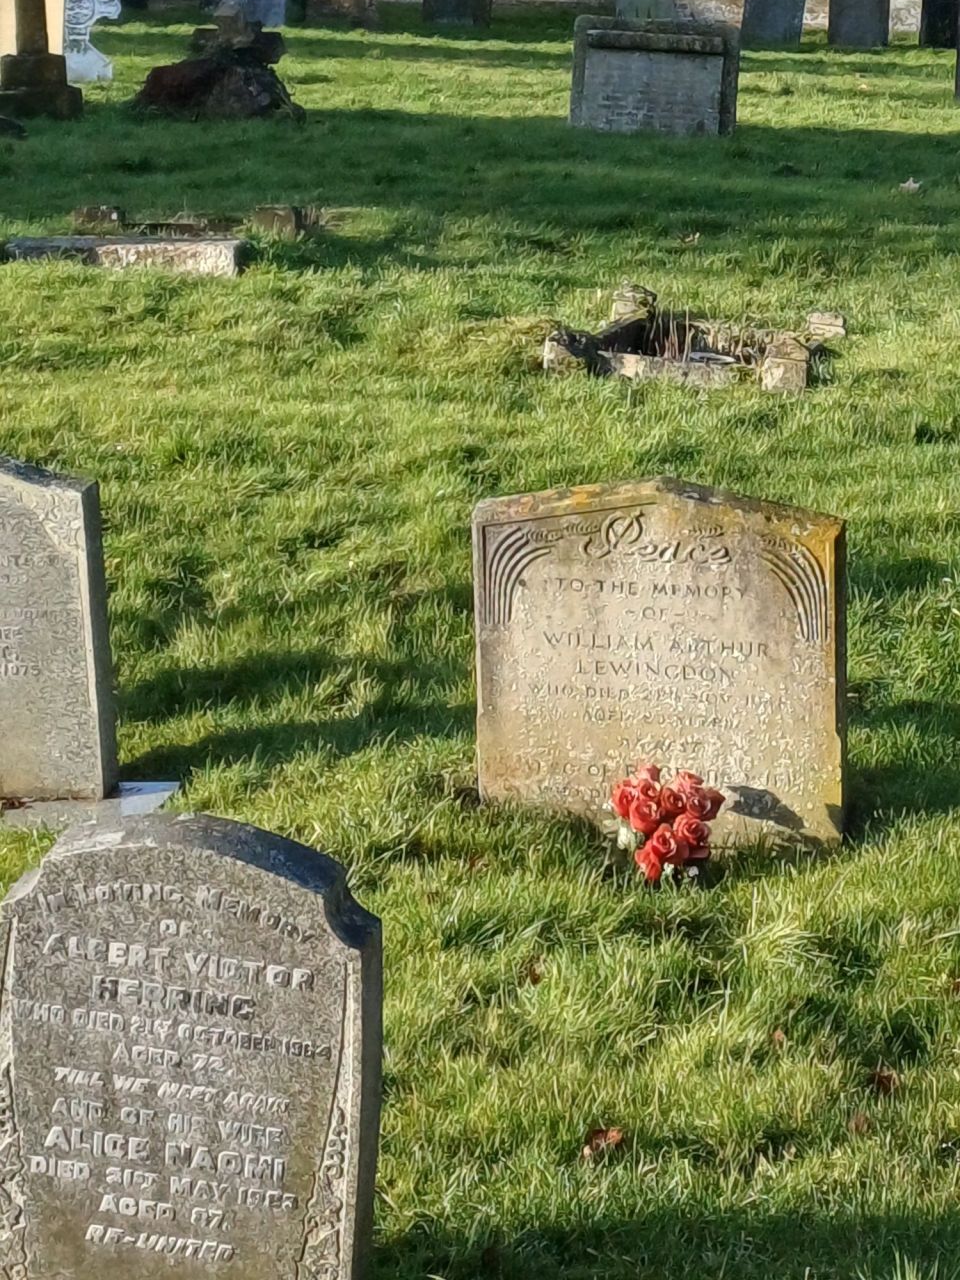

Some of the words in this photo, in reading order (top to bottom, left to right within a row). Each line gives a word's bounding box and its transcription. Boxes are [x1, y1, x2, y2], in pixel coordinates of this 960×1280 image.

[593, 579, 638, 596] THE
[543, 630, 653, 653] WILLIAM
[669, 638, 770, 658] ARTHUR
[75, 880, 184, 909] LOVING
[197, 884, 316, 944] MEMORY
[42, 932, 171, 970] ALBERT
[185, 951, 314, 992] VICTOR
[91, 974, 257, 1020] HERRING
[73, 1007, 126, 1033] DIED
[112, 1043, 182, 1069] AGED
[112, 1073, 151, 1093] WE
[51, 1096, 104, 1121] AND
[120, 1106, 156, 1127] OF
[218, 1120, 288, 1150] WIFE
[44, 1125, 151, 1164] ALICE
[165, 1140, 286, 1185] NAOMI
[28, 1155, 91, 1180] DIED
[170, 1176, 230, 1202] MAY
[99, 1194, 177, 1222] AGED
